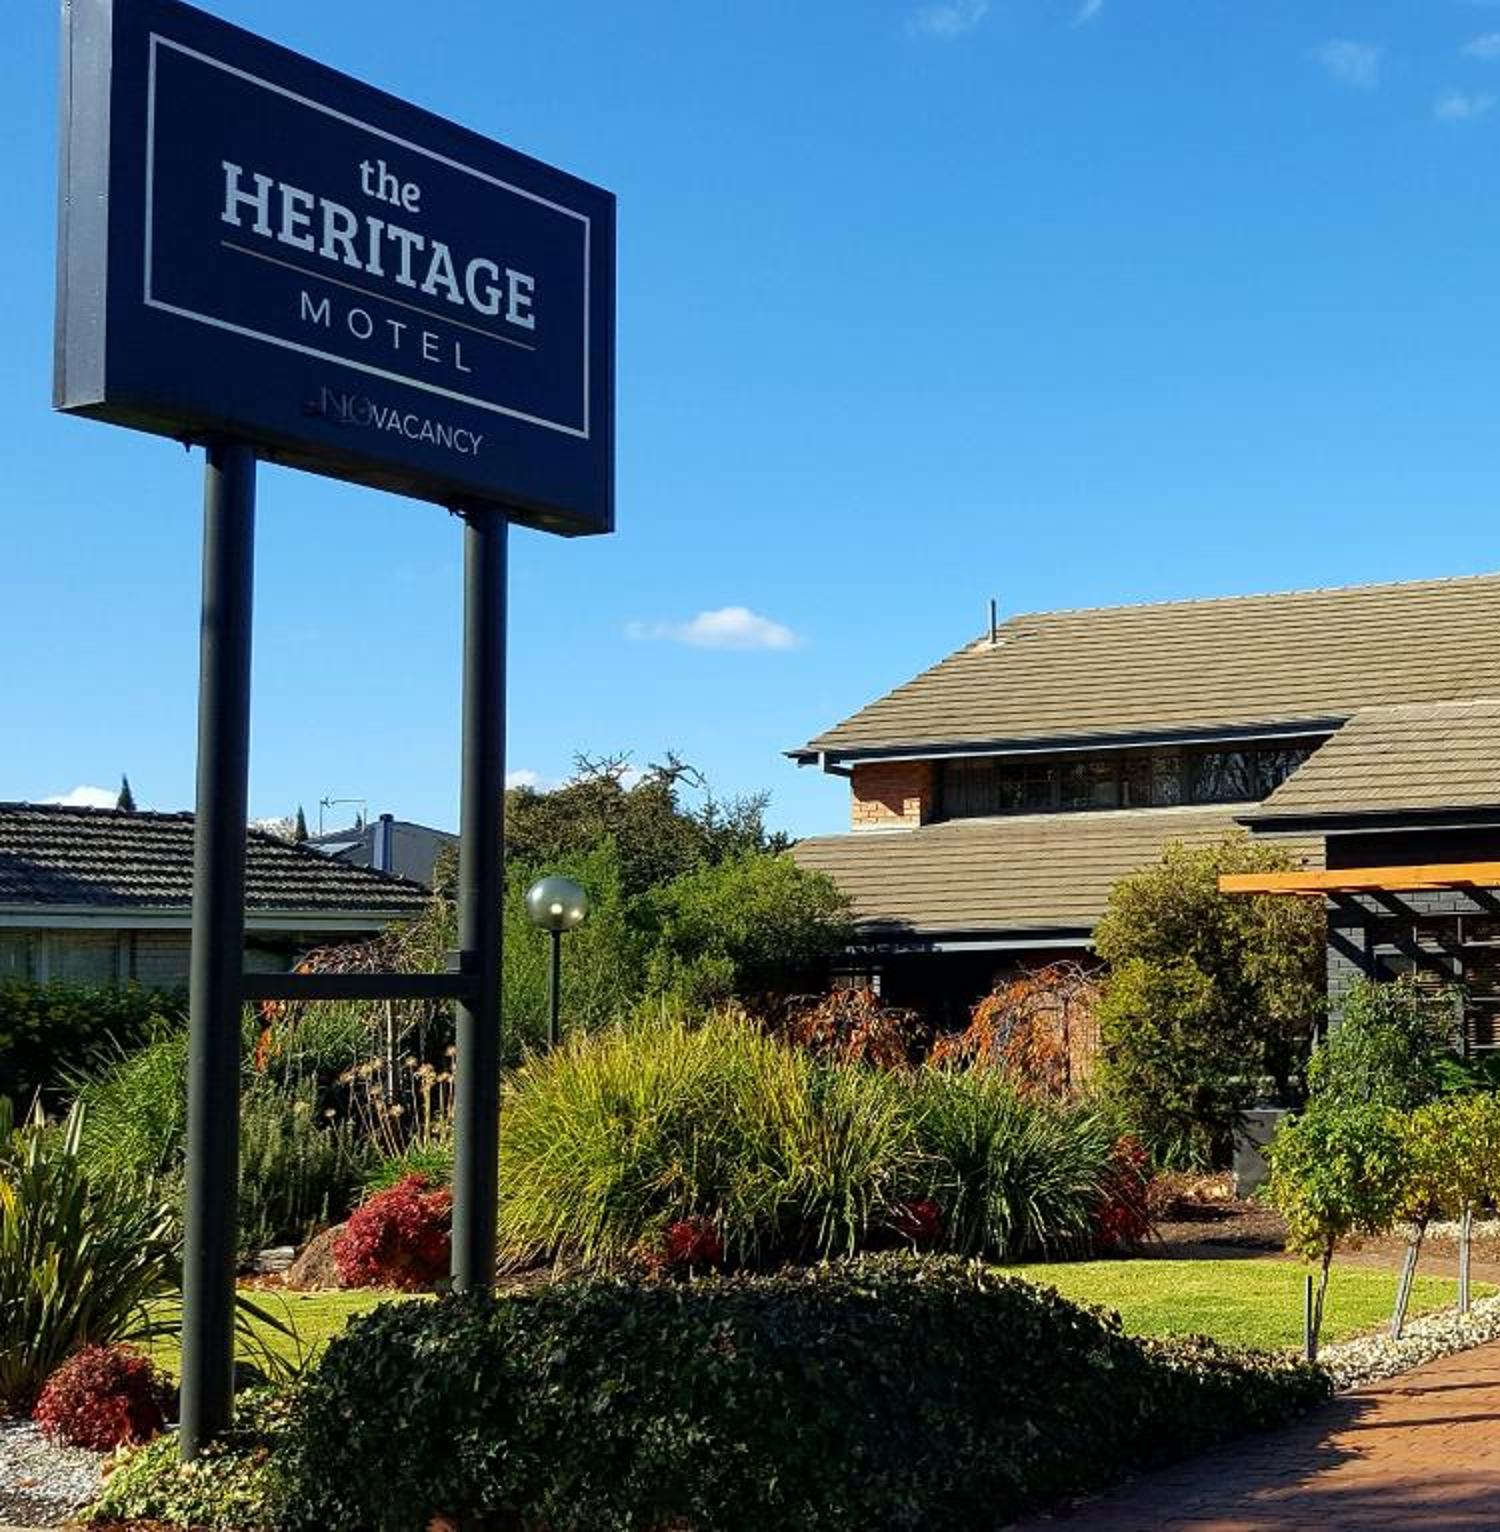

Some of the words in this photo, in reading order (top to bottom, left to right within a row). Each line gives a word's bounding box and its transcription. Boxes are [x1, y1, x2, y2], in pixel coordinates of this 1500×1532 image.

[359, 159, 422, 213] the
[220, 159, 536, 331] HERITAGE
[300, 290, 473, 374] MOTEL
[371, 404, 484, 456] VACANCY
